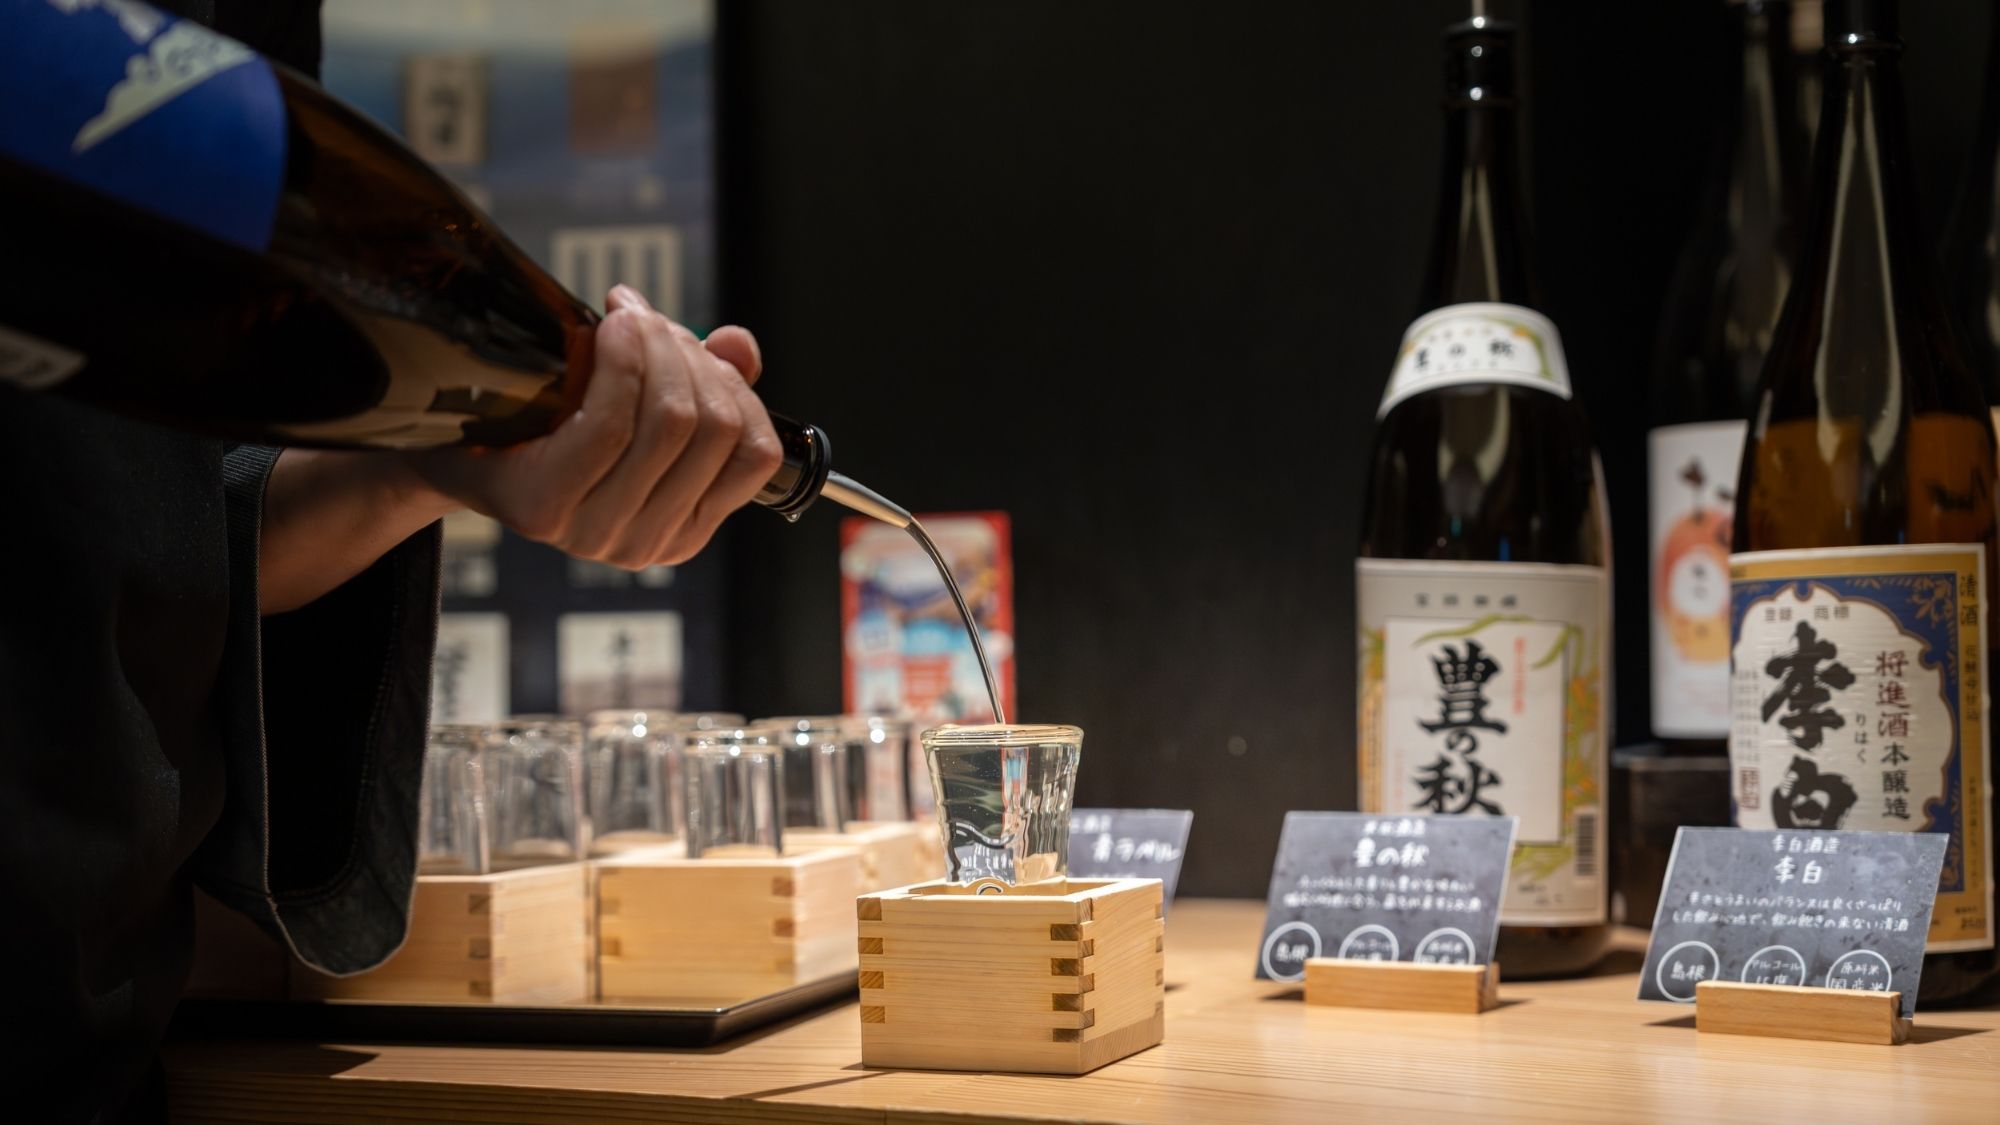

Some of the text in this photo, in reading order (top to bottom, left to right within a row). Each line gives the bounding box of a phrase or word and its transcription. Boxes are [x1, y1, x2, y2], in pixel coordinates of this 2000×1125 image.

[1960, 572, 1979, 627] 清酒
[1411, 639, 1508, 814] 豊の秋
[1762, 620, 1857, 829] 李白
[1855, 712, 1869, 764] りはく
[1353, 837, 1430, 867] 豊の秋
[1772, 834, 1840, 855] 李白酒造
[1774, 856, 1824, 885] 李白
[1670, 961, 1706, 981] 島根
[1750, 957, 1802, 971] アルコール
[1840, 961, 1881, 976] 原料米
